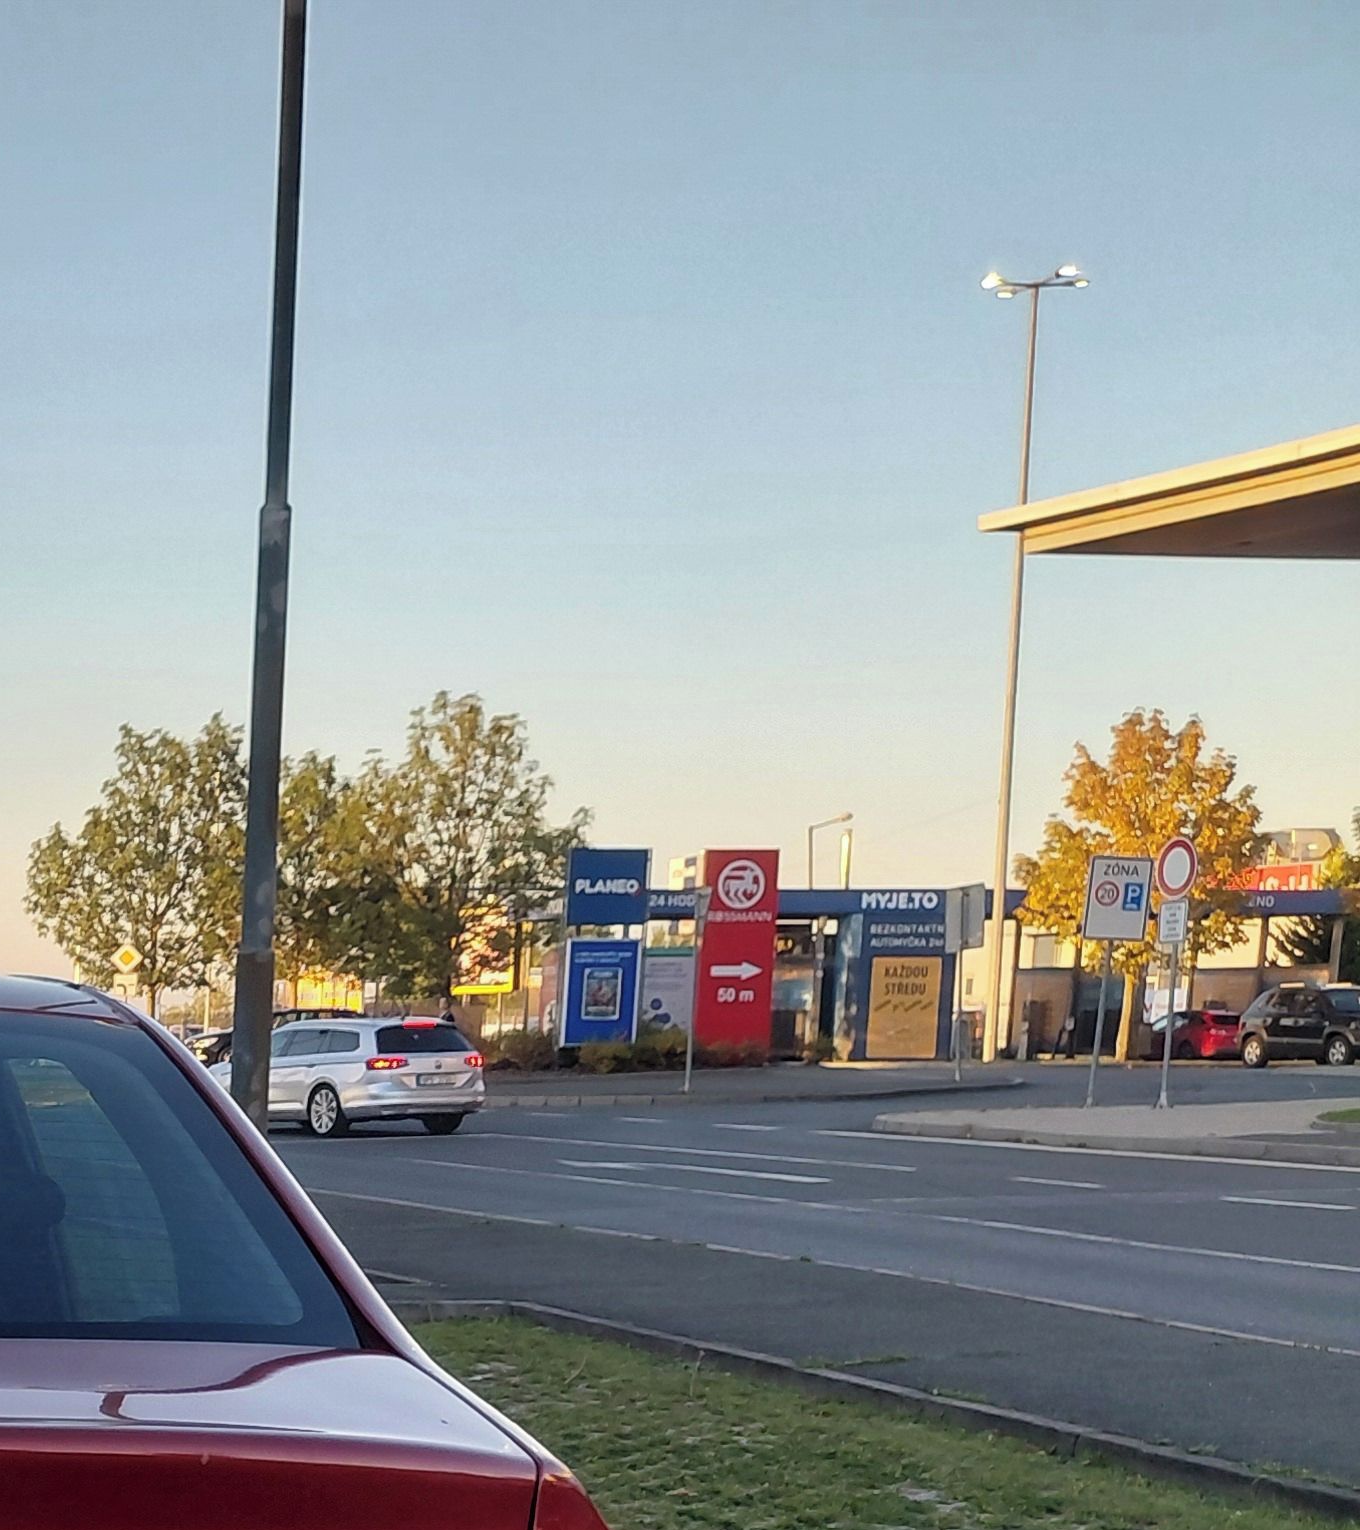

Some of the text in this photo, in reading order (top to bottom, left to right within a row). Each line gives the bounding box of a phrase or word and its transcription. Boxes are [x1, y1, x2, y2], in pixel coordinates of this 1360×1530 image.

[1103, 862, 1139, 876] ZÓNA
[1100, 887, 1115, 900] 20
[649, 895, 665, 907] 24
[861, 891, 939, 910] MYJE.TO
[870, 923, 944, 935] BEZKONTAKTN
[884, 965, 929, 978] KAŽDOU
[884, 982, 927, 996] STŘEDU
[739, 990, 755, 1003] m
